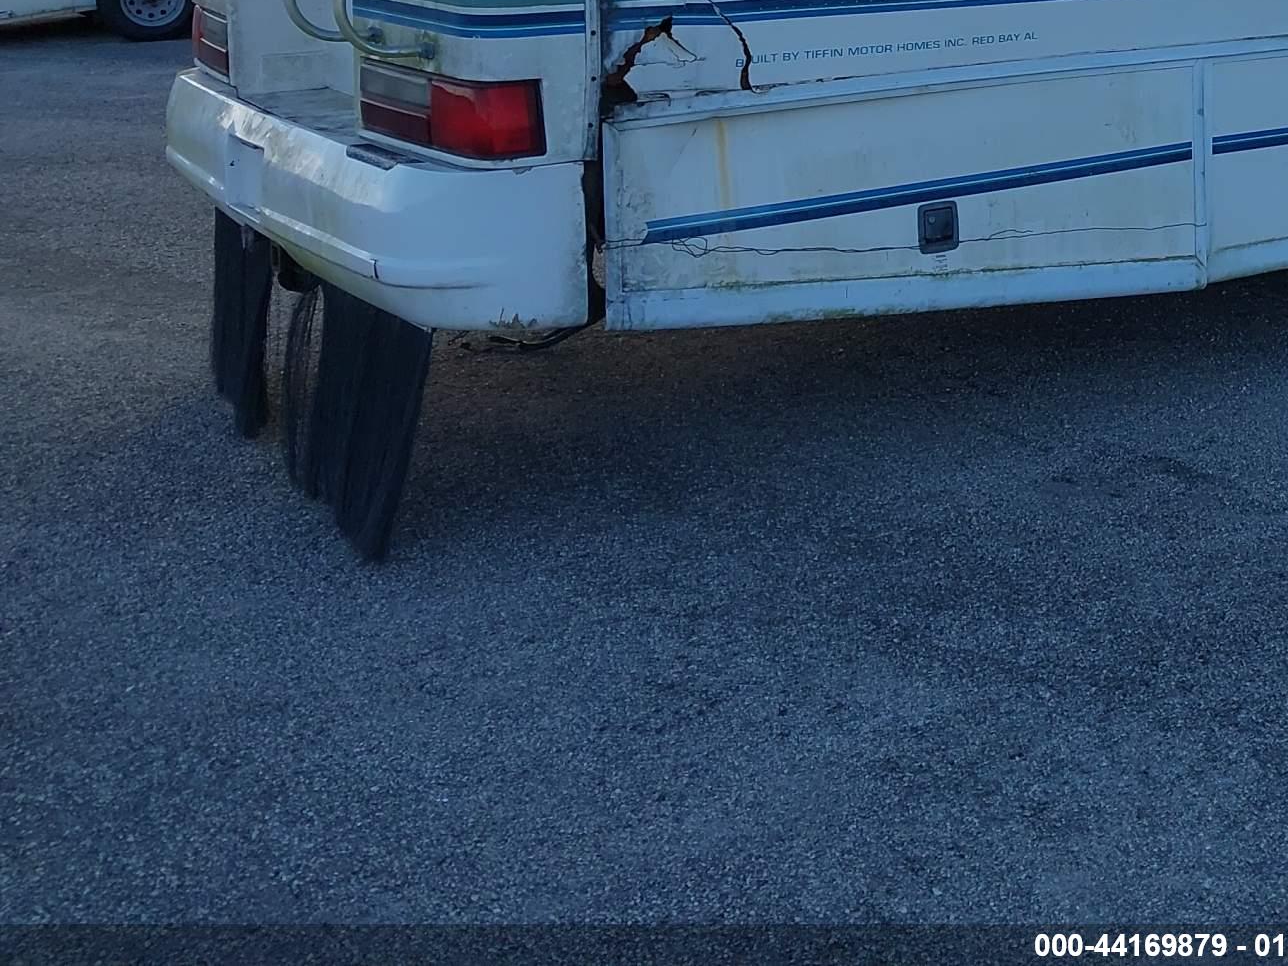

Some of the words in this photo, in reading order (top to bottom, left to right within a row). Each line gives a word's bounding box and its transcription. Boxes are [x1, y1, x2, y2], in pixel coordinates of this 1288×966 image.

[735, 53, 779, 68] BUILT
[782, 51, 799, 62] BY
[804, 47, 843, 60] TIFFIN
[847, 44, 893, 56] MOTOR
[896, 40, 941, 52] HOMES
[944, 37, 968, 48] INC.
[972, 35, 995, 46] RED
[998, 33, 1021, 43] BAY
[1023, 31, 1038, 41] AL
